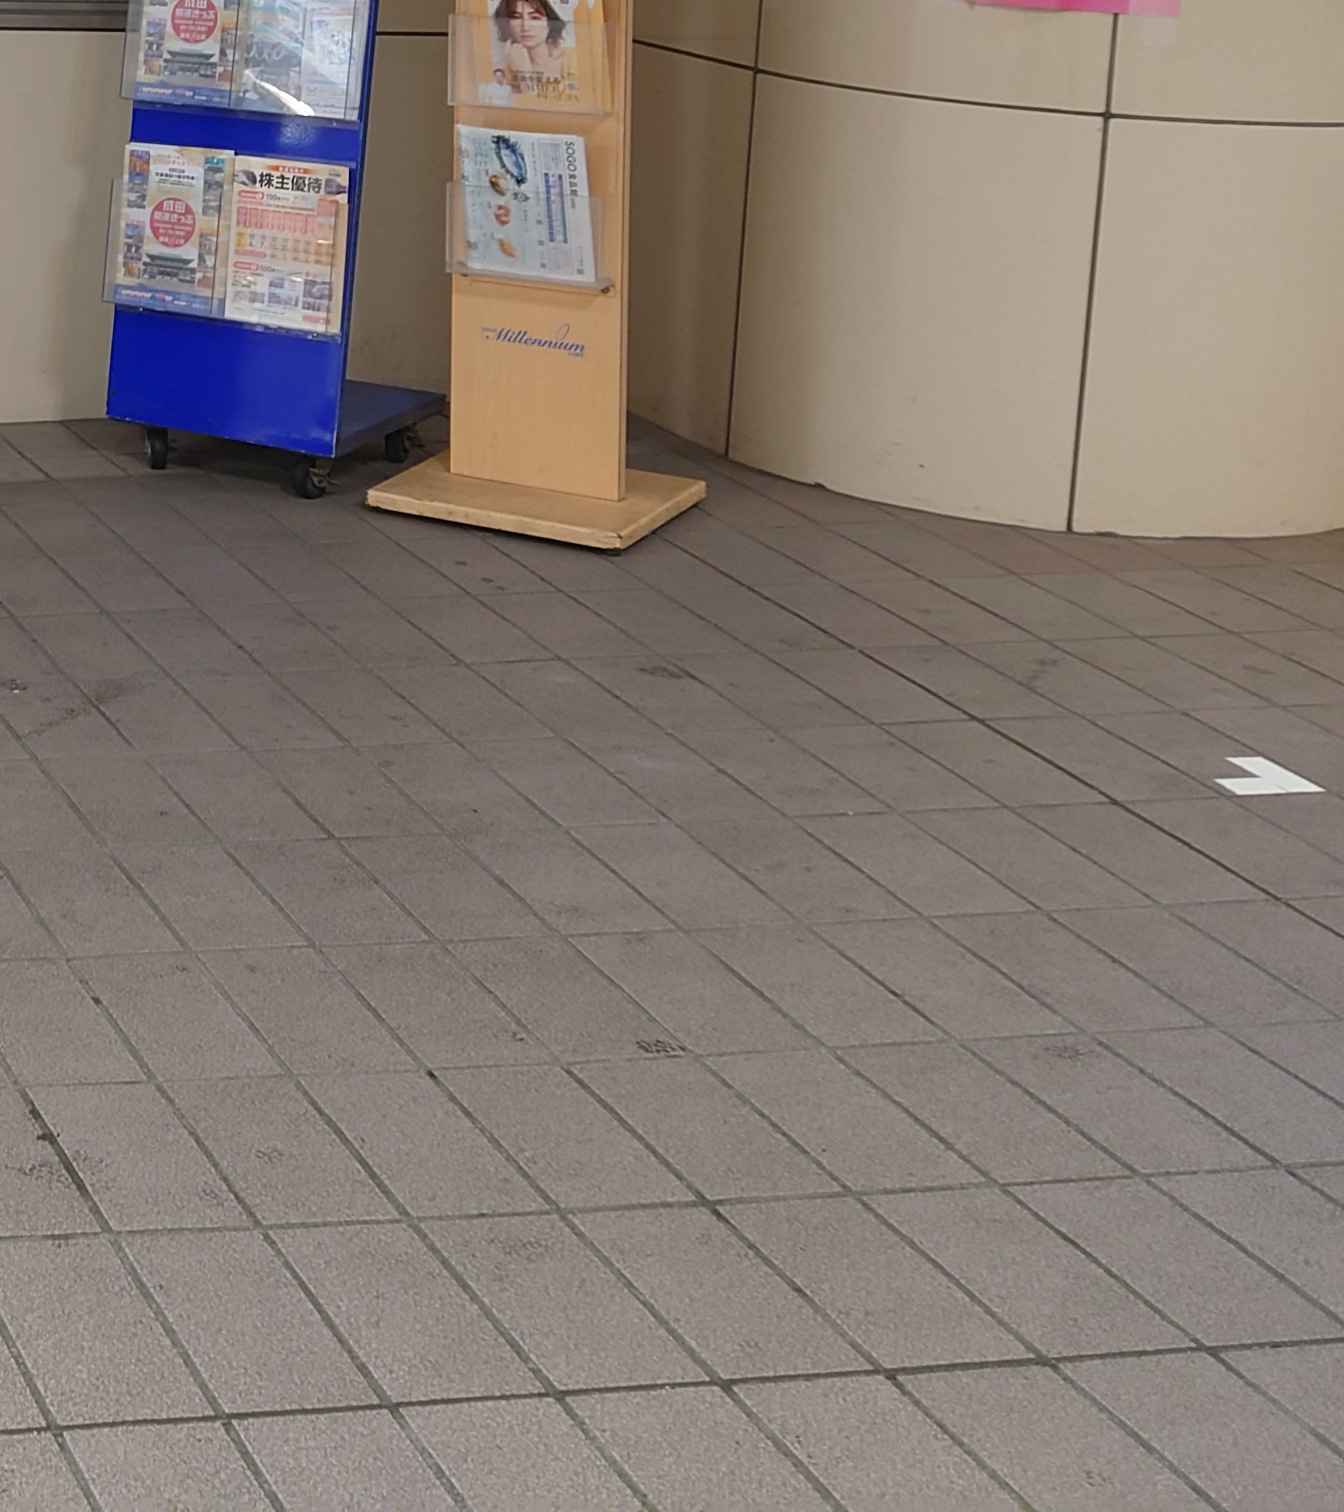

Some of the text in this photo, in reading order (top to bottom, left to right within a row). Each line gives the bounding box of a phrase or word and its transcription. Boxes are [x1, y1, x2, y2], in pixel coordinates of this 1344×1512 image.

[258, 171, 323, 193] 株主優待
[486, 324, 585, 352] Millennium
